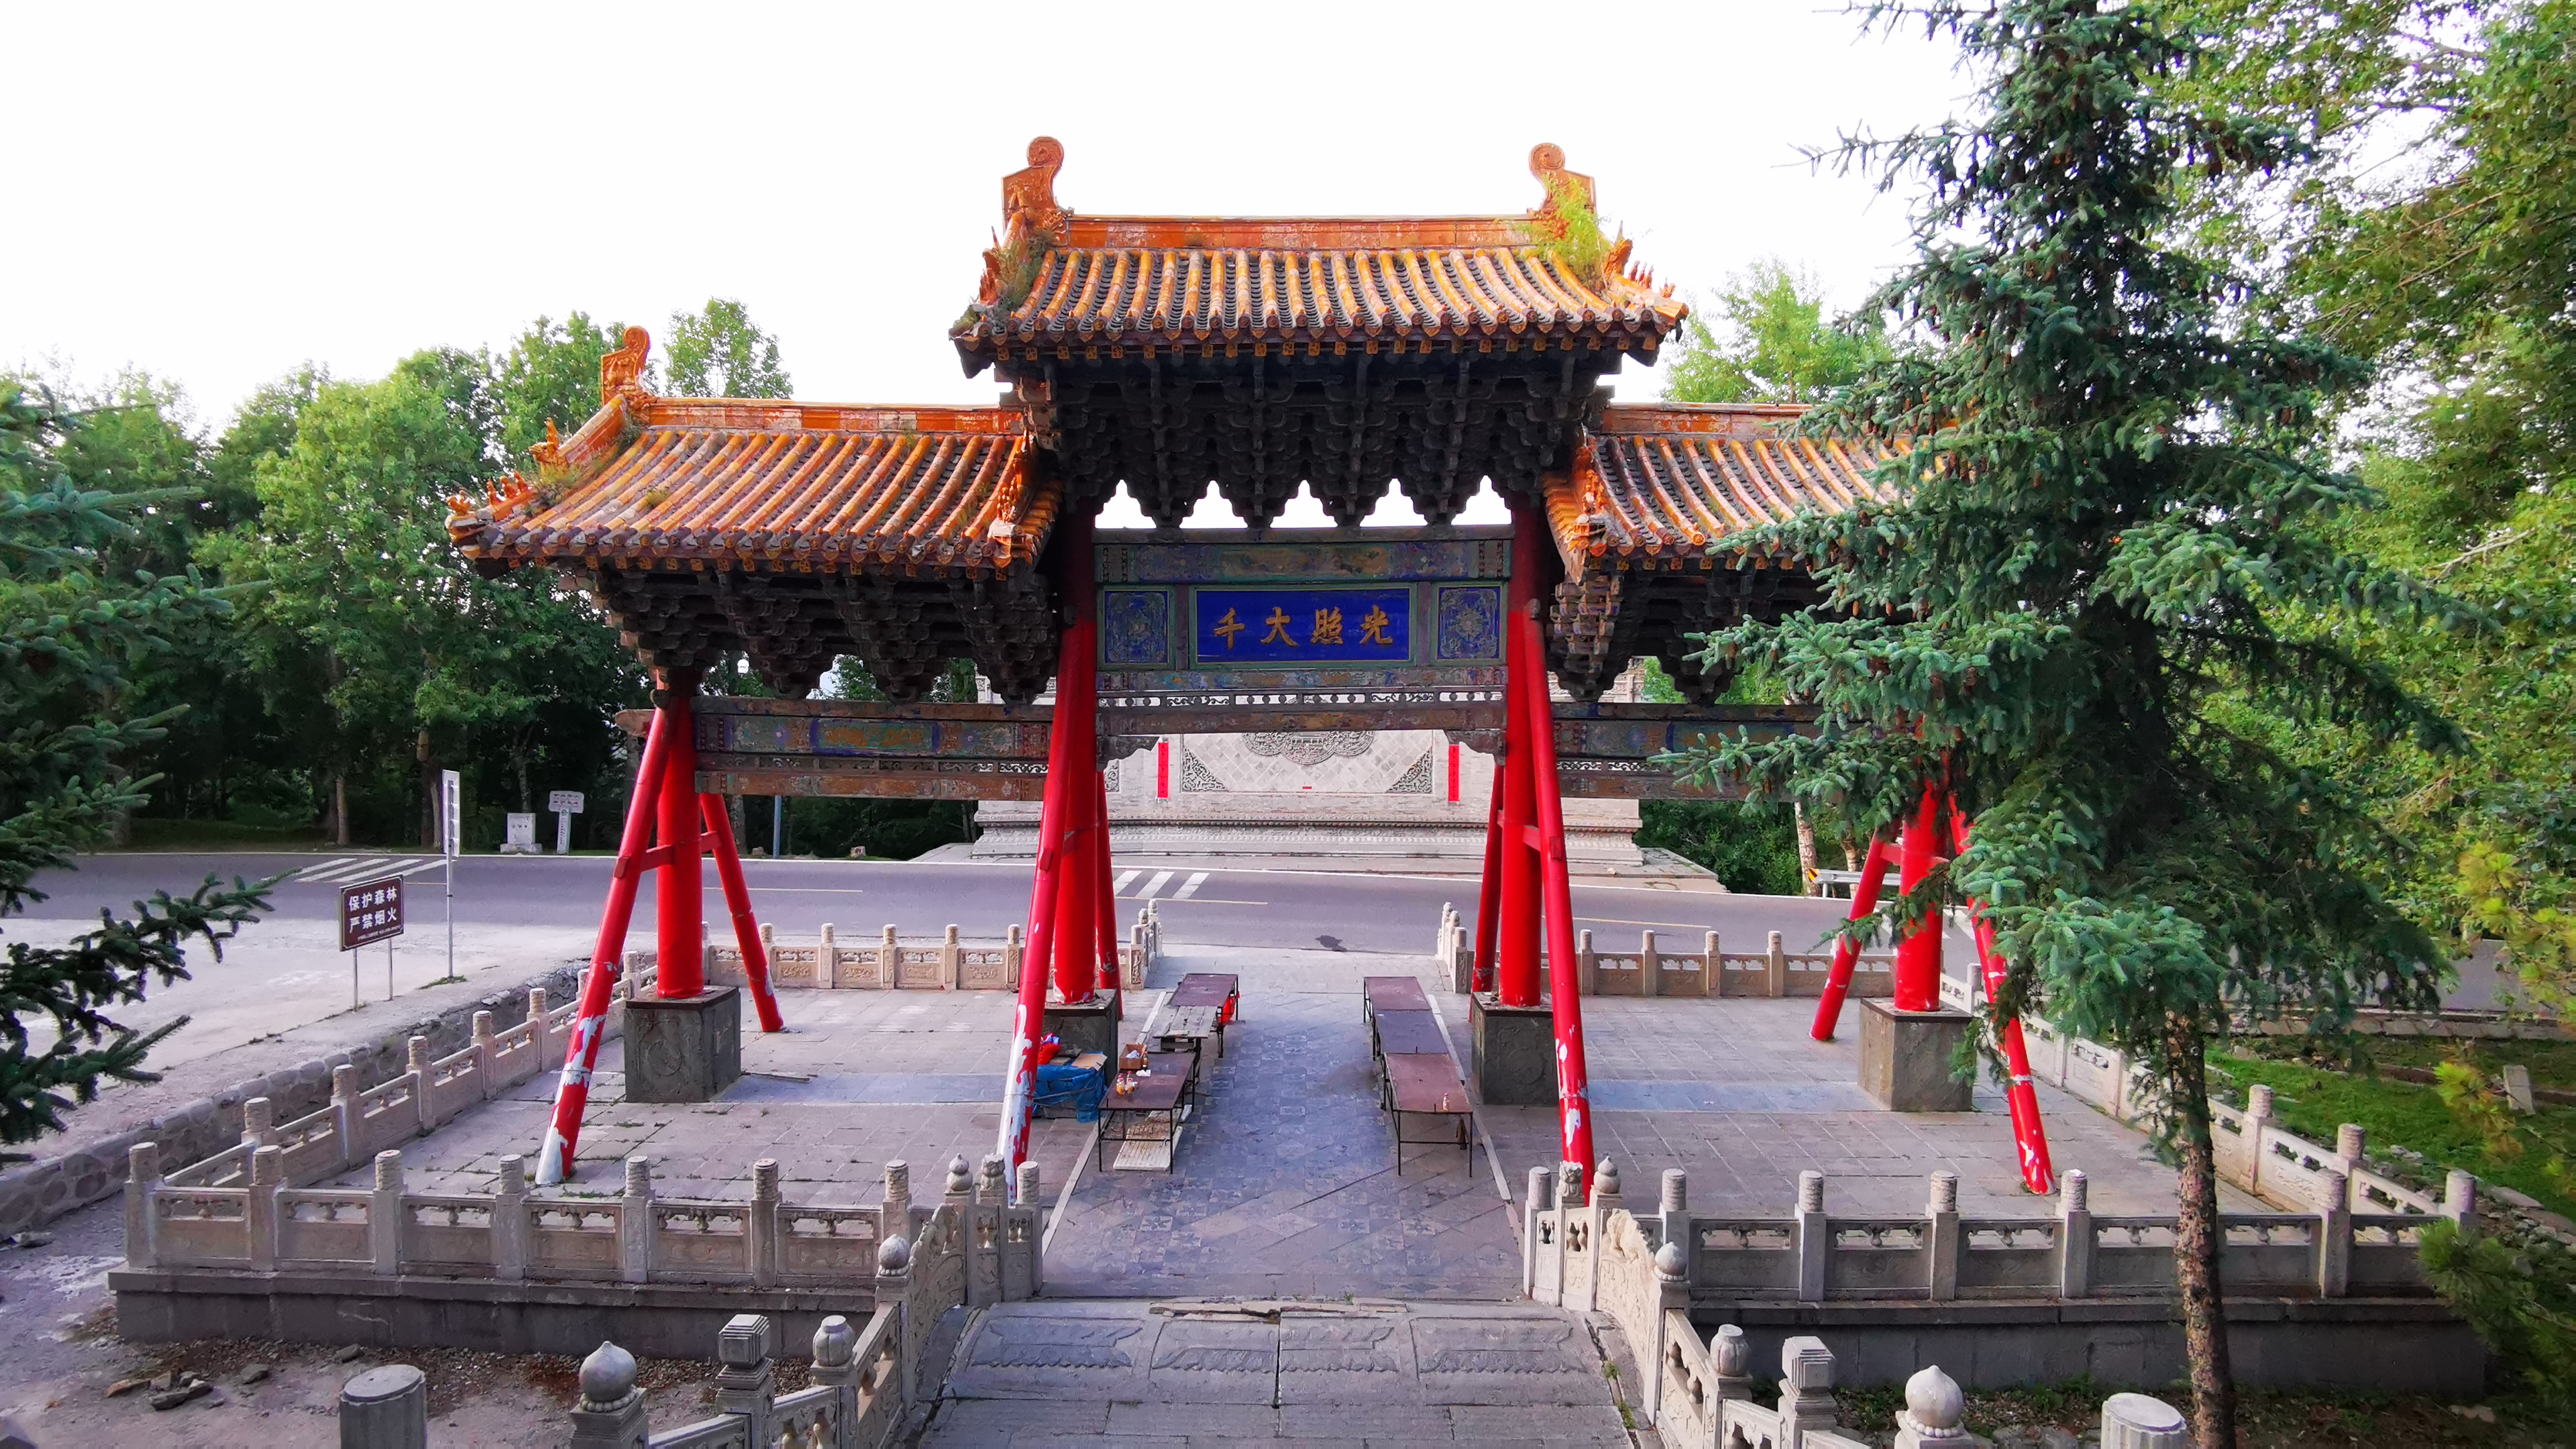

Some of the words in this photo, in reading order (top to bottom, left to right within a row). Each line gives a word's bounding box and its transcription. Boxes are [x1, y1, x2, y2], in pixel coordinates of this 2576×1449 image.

[349, 885, 397, 912] 保护森林
[349, 907, 398, 934] 严禁烟火
